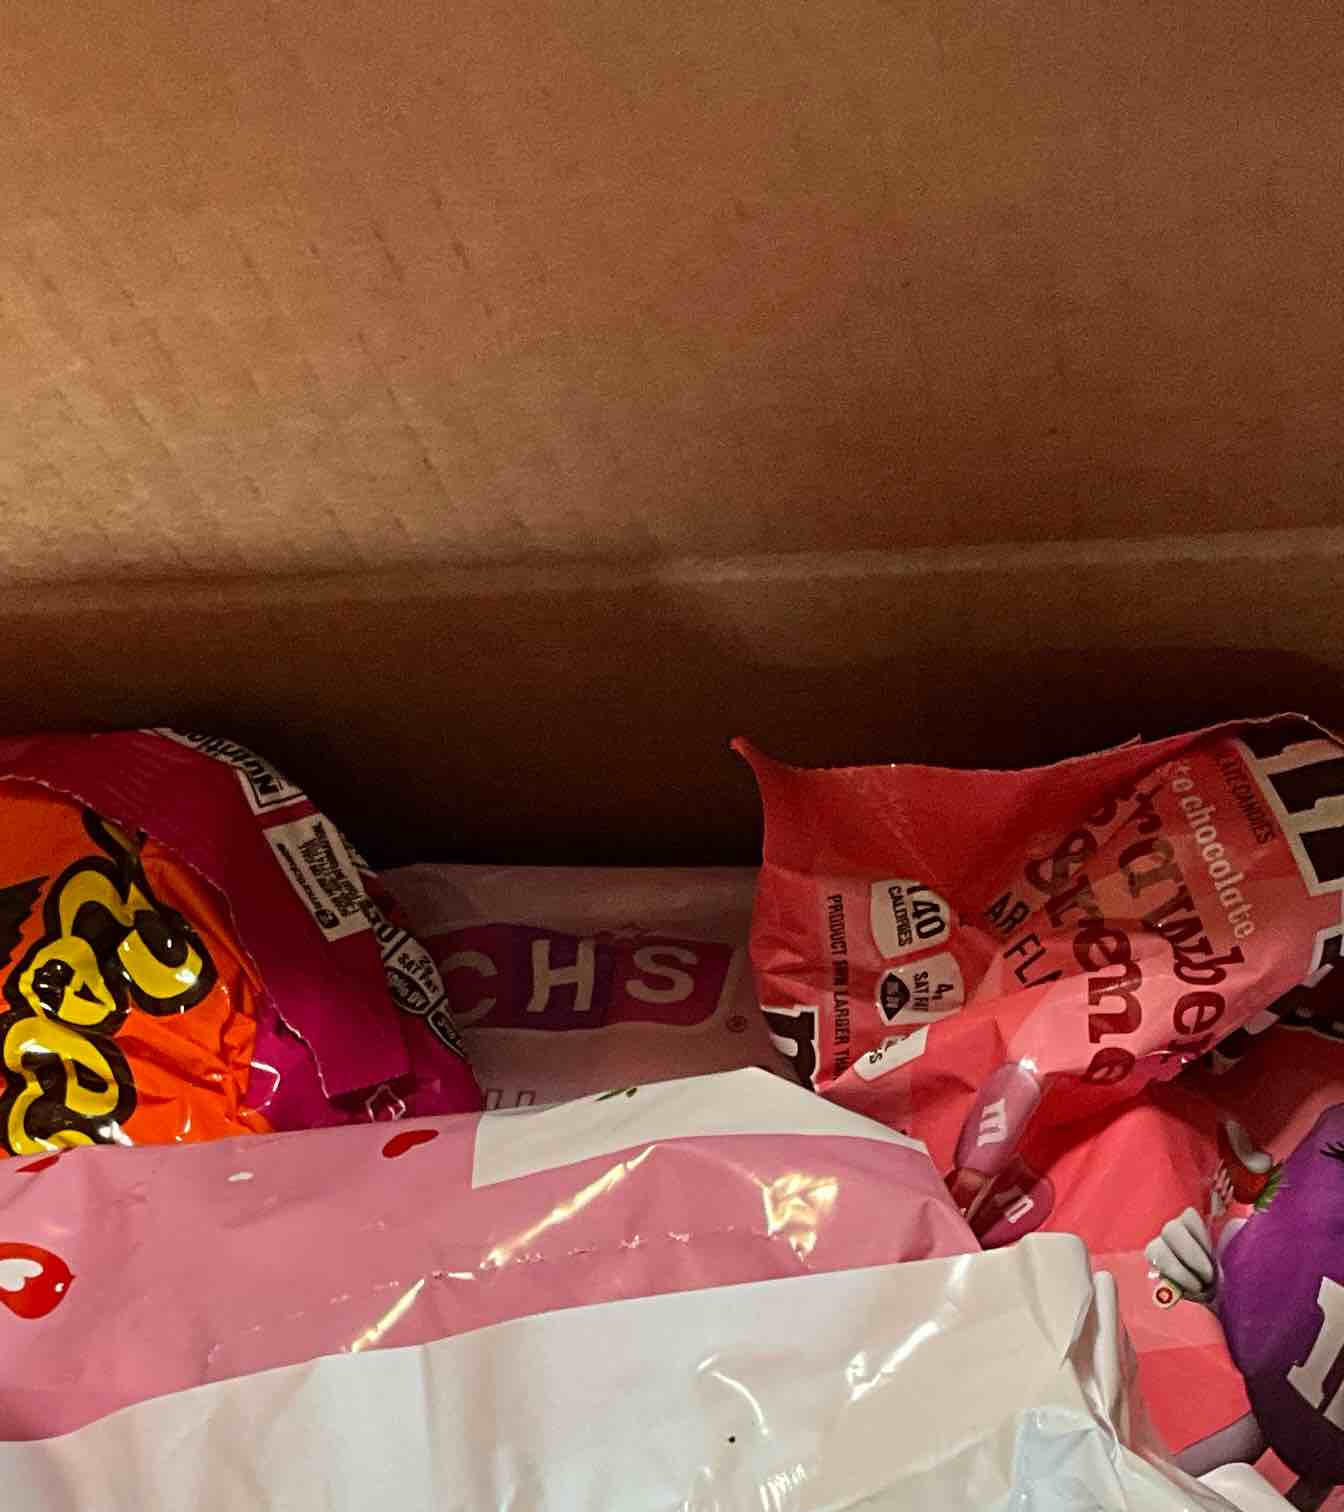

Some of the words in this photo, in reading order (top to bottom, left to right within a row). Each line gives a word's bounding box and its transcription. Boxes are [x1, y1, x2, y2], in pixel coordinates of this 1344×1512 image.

[1182, 791, 1257, 941] chocolate
[827, 894, 848, 961] PRODUCT
[887, 886, 913, 947] CALORIES
[832, 987, 851, 1047] LARGER
